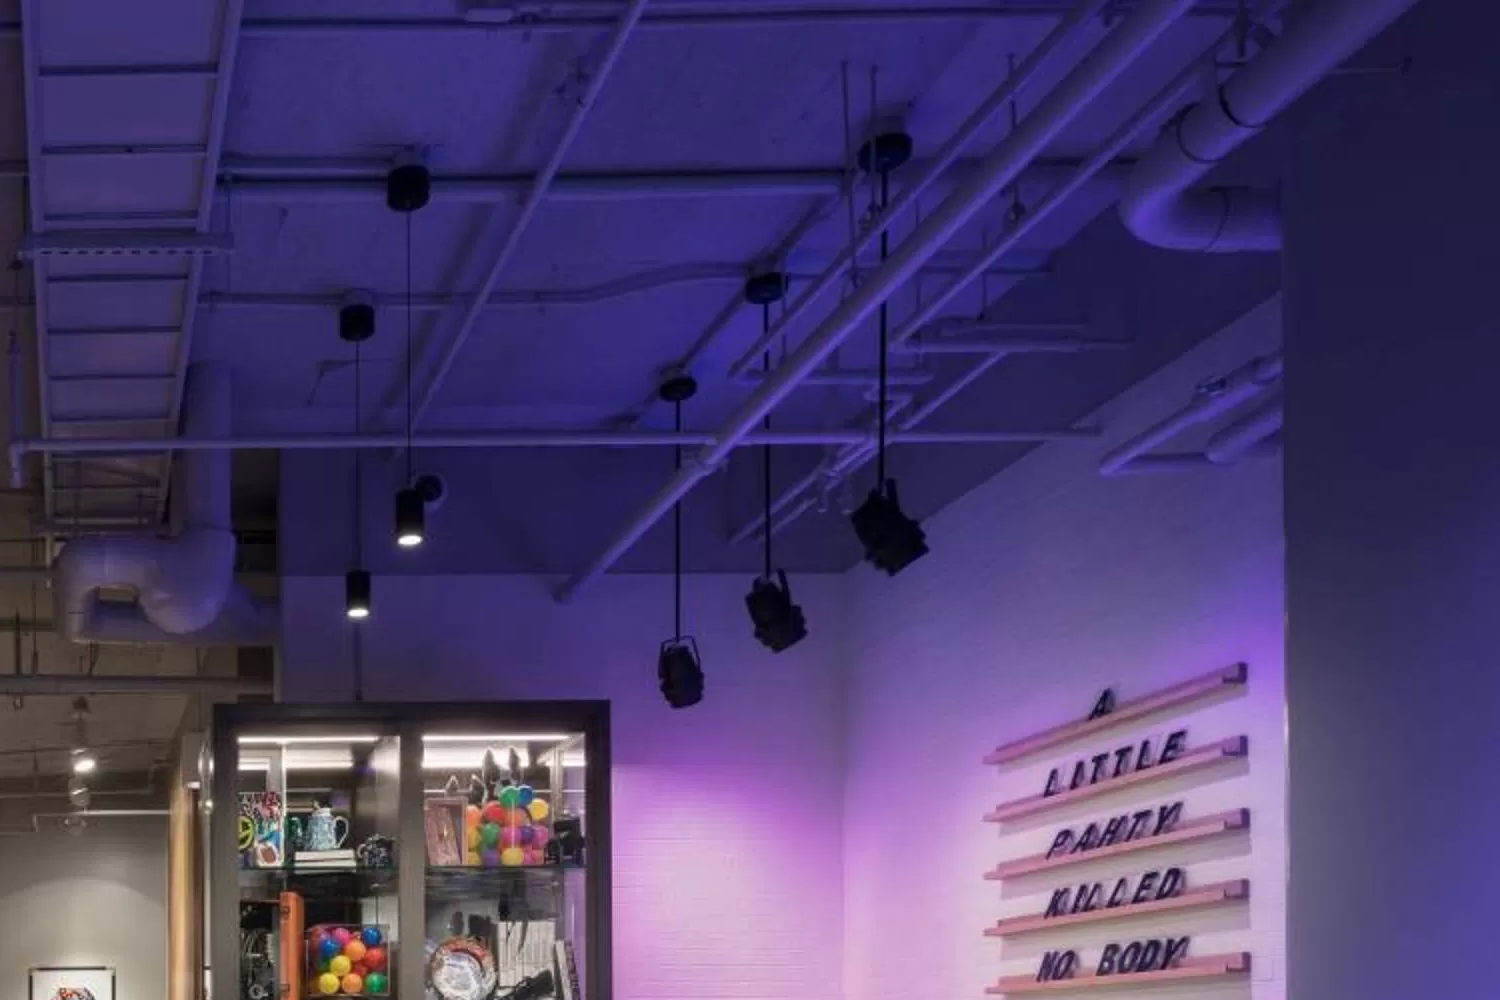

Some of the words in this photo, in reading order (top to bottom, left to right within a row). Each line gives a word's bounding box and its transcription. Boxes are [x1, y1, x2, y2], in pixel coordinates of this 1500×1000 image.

[1088, 687, 1116, 721] A
[1044, 728, 1188, 798] LITTLE
[1044, 867, 1185, 919] KILLED
[1036, 950, 1078, 982] NO
[1095, 935, 1190, 976] BODY
